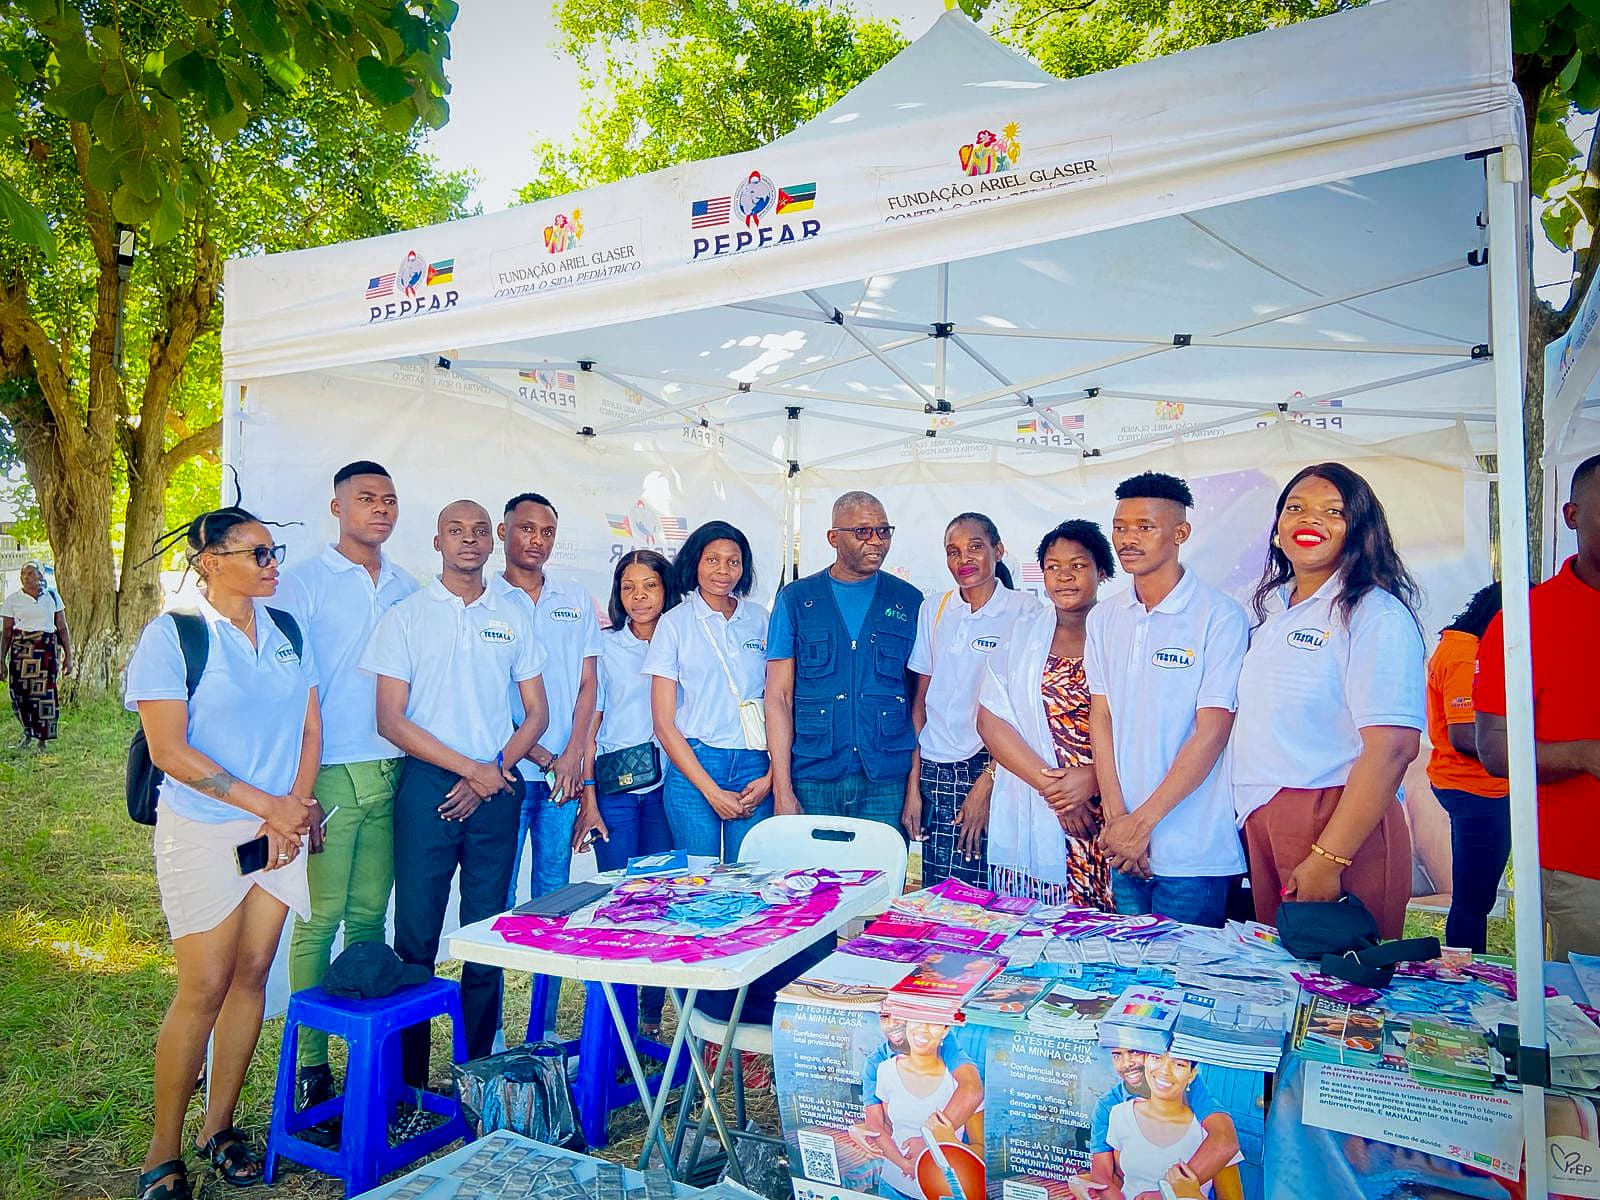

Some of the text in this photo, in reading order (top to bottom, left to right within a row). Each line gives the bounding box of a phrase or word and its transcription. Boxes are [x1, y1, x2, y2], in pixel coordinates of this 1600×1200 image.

[888, 183, 973, 209] FUNDAÇÃO
[980, 175, 1026, 193] ARIEL
[1030, 160, 1098, 182] GLASER
[693, 220, 820, 259] PEPFAR
[499, 246, 635, 284] FUNDAÇÃO ARIEL GLASER
[495, 284, 534, 298] CONTRA
[577, 261, 640, 283] PEDIÁTRICO
[370, 290, 458, 322] PEPFAR
[484, 632, 503, 640] TESTA
[1293, 632, 1312, 644] TESTA
[1156, 652, 1177, 663] TESTA
[913, 979, 957, 988] MITOS
[809, 1014, 836, 1024] MINHA
[839, 1018, 862, 1028] CASA
[1012, 1044, 1092, 1064] NA MINHA CASA
[1024, 1036, 1054, 1048] TESTE
[1057, 1041, 1070, 1050] DE
[1074, 1044, 1092, 1055] HIV,
[1010, 1062, 1054, 1076] Confidencial
[1010, 1070, 1025, 1078] total
[1334, 1066, 1362, 1075] podes
[1365, 1071, 1404, 1081] levantar
[1321, 1070, 1391, 1085] antirretrovirais
[1394, 1082, 1422, 1090] numa
[1470, 1094, 1511, 1105] privada.
[1017, 1091, 1043, 1102] seguro,
[1045, 1095, 1066, 1104] eficaz
[1355, 1092, 1372, 1100] para
[1374, 1095, 1403, 1105] saberes
[1405, 1101, 1426, 1109] quais
[1428, 1104, 1441, 1112] são
[1443, 1100, 1456, 1108] fala
[1010, 1099, 1036, 1109] demora
[1048, 1105, 1058, 1113] 20
[1060, 1109, 1088, 1119] minutos
[1320, 1092, 1351, 1102] privadas
[1366, 1101, 1380, 1109] que
[1382, 1104, 1405, 1112] podes
[1407, 1107, 1438, 1118] levantar
[1451, 1117, 1468, 1125] teus
[1385, 1111, 1421, 1123] MAHALA!
[1010, 1110, 1026, 1118] para
[1028, 1112, 1048, 1121] saber
[1056, 1117, 1090, 1129] resultado
[1010, 1138, 1030, 1148] PEDE
[1032, 1140, 1041, 1150] JÁ
[1051, 1145, 1067, 1154] TEU
[1069, 1149, 1093, 1160] TESTE
[1010, 1147, 1041, 1160] MAHALA
[1051, 1154, 1063, 1163] UM
[1066, 1158, 1092, 1169] ACTOR
[1010, 1165, 1025, 1174] TUA
[1011, 1156, 1077, 1175] COMUNITÁRIO NA
[1564, 1152, 1592, 1175] PrEP
